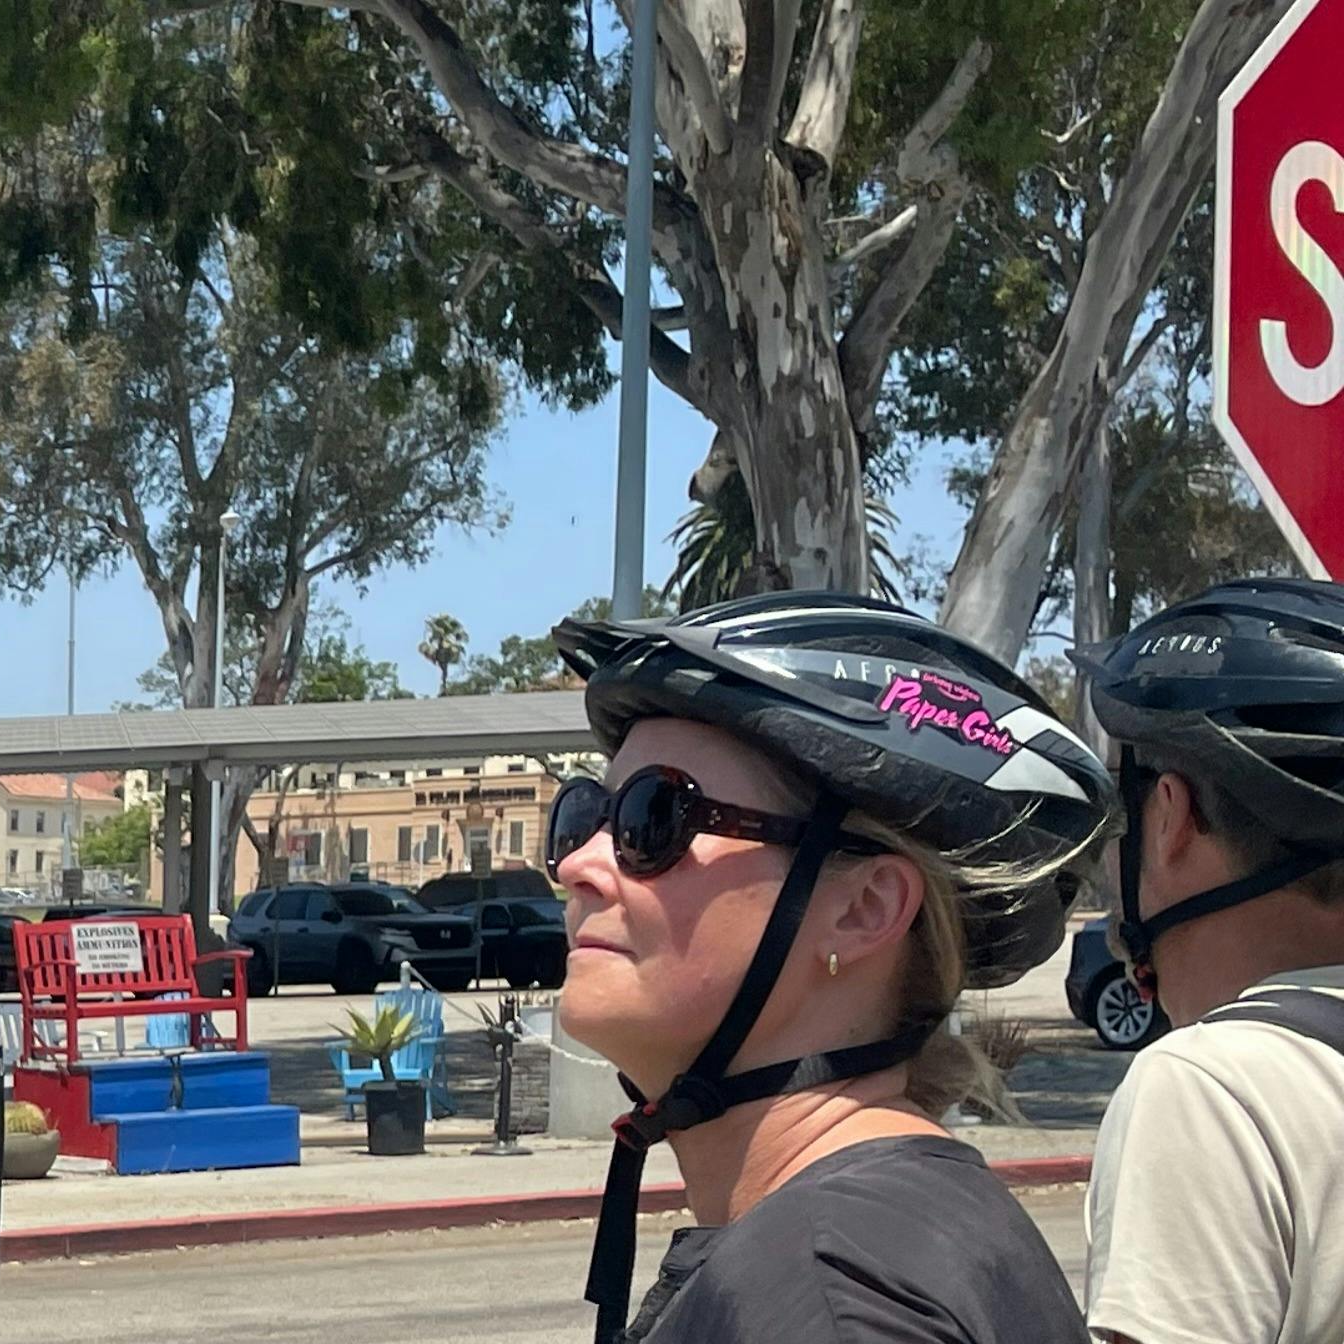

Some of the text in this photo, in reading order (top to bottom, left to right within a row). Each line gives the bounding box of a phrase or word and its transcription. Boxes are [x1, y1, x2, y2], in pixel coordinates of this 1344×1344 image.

[878, 677, 1013, 755] Paper Girls
[76, 926, 135, 938] EXPLOSIVES
[76, 939, 139, 950] AMMUNITION
